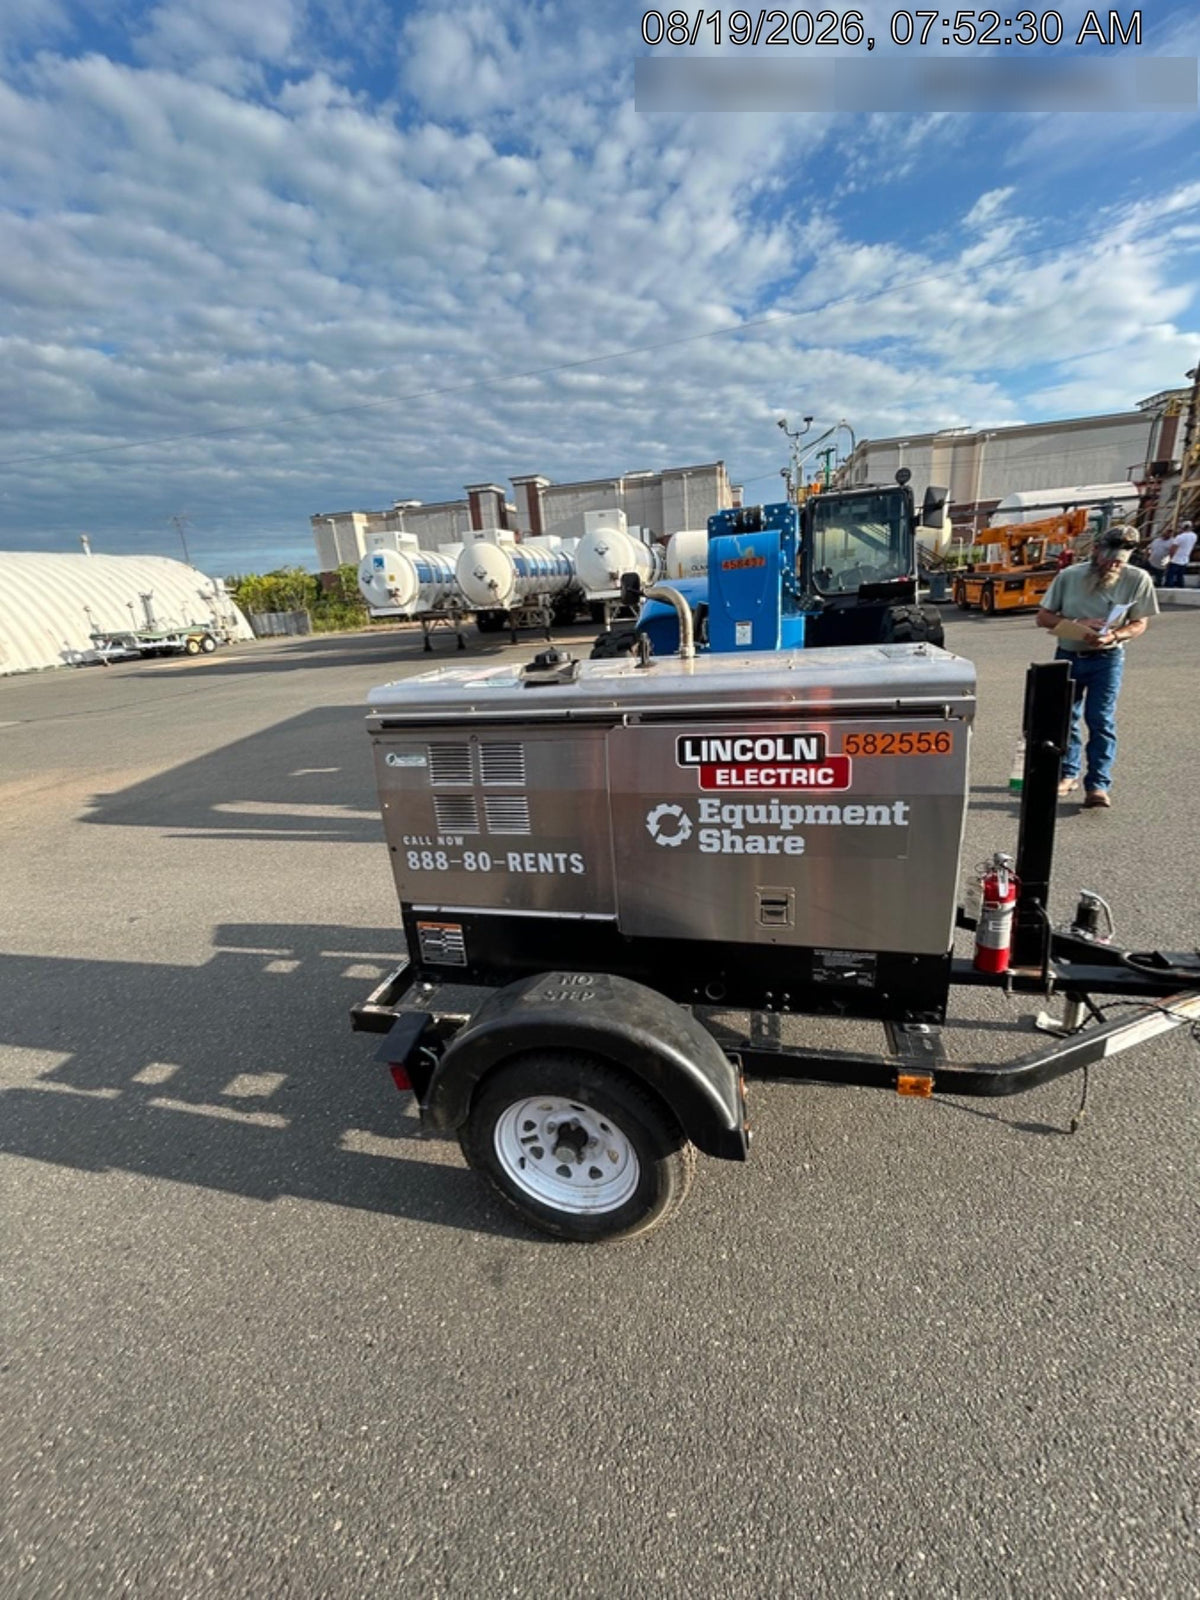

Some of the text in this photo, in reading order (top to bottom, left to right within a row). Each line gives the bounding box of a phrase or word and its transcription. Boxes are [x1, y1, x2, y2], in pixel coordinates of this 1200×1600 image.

[684, 737, 818, 762] LINCOLN
[845, 731, 951, 755] 582556
[715, 767, 835, 785] ELECTRIC
[698, 798, 910, 830] Equipment
[402, 835, 465, 846] CALL NOW
[698, 828, 806, 855] Share
[406, 850, 586, 874] 888-80-RENTS
[560, 975, 594, 986] NO
[543, 991, 596, 1001] STEP
